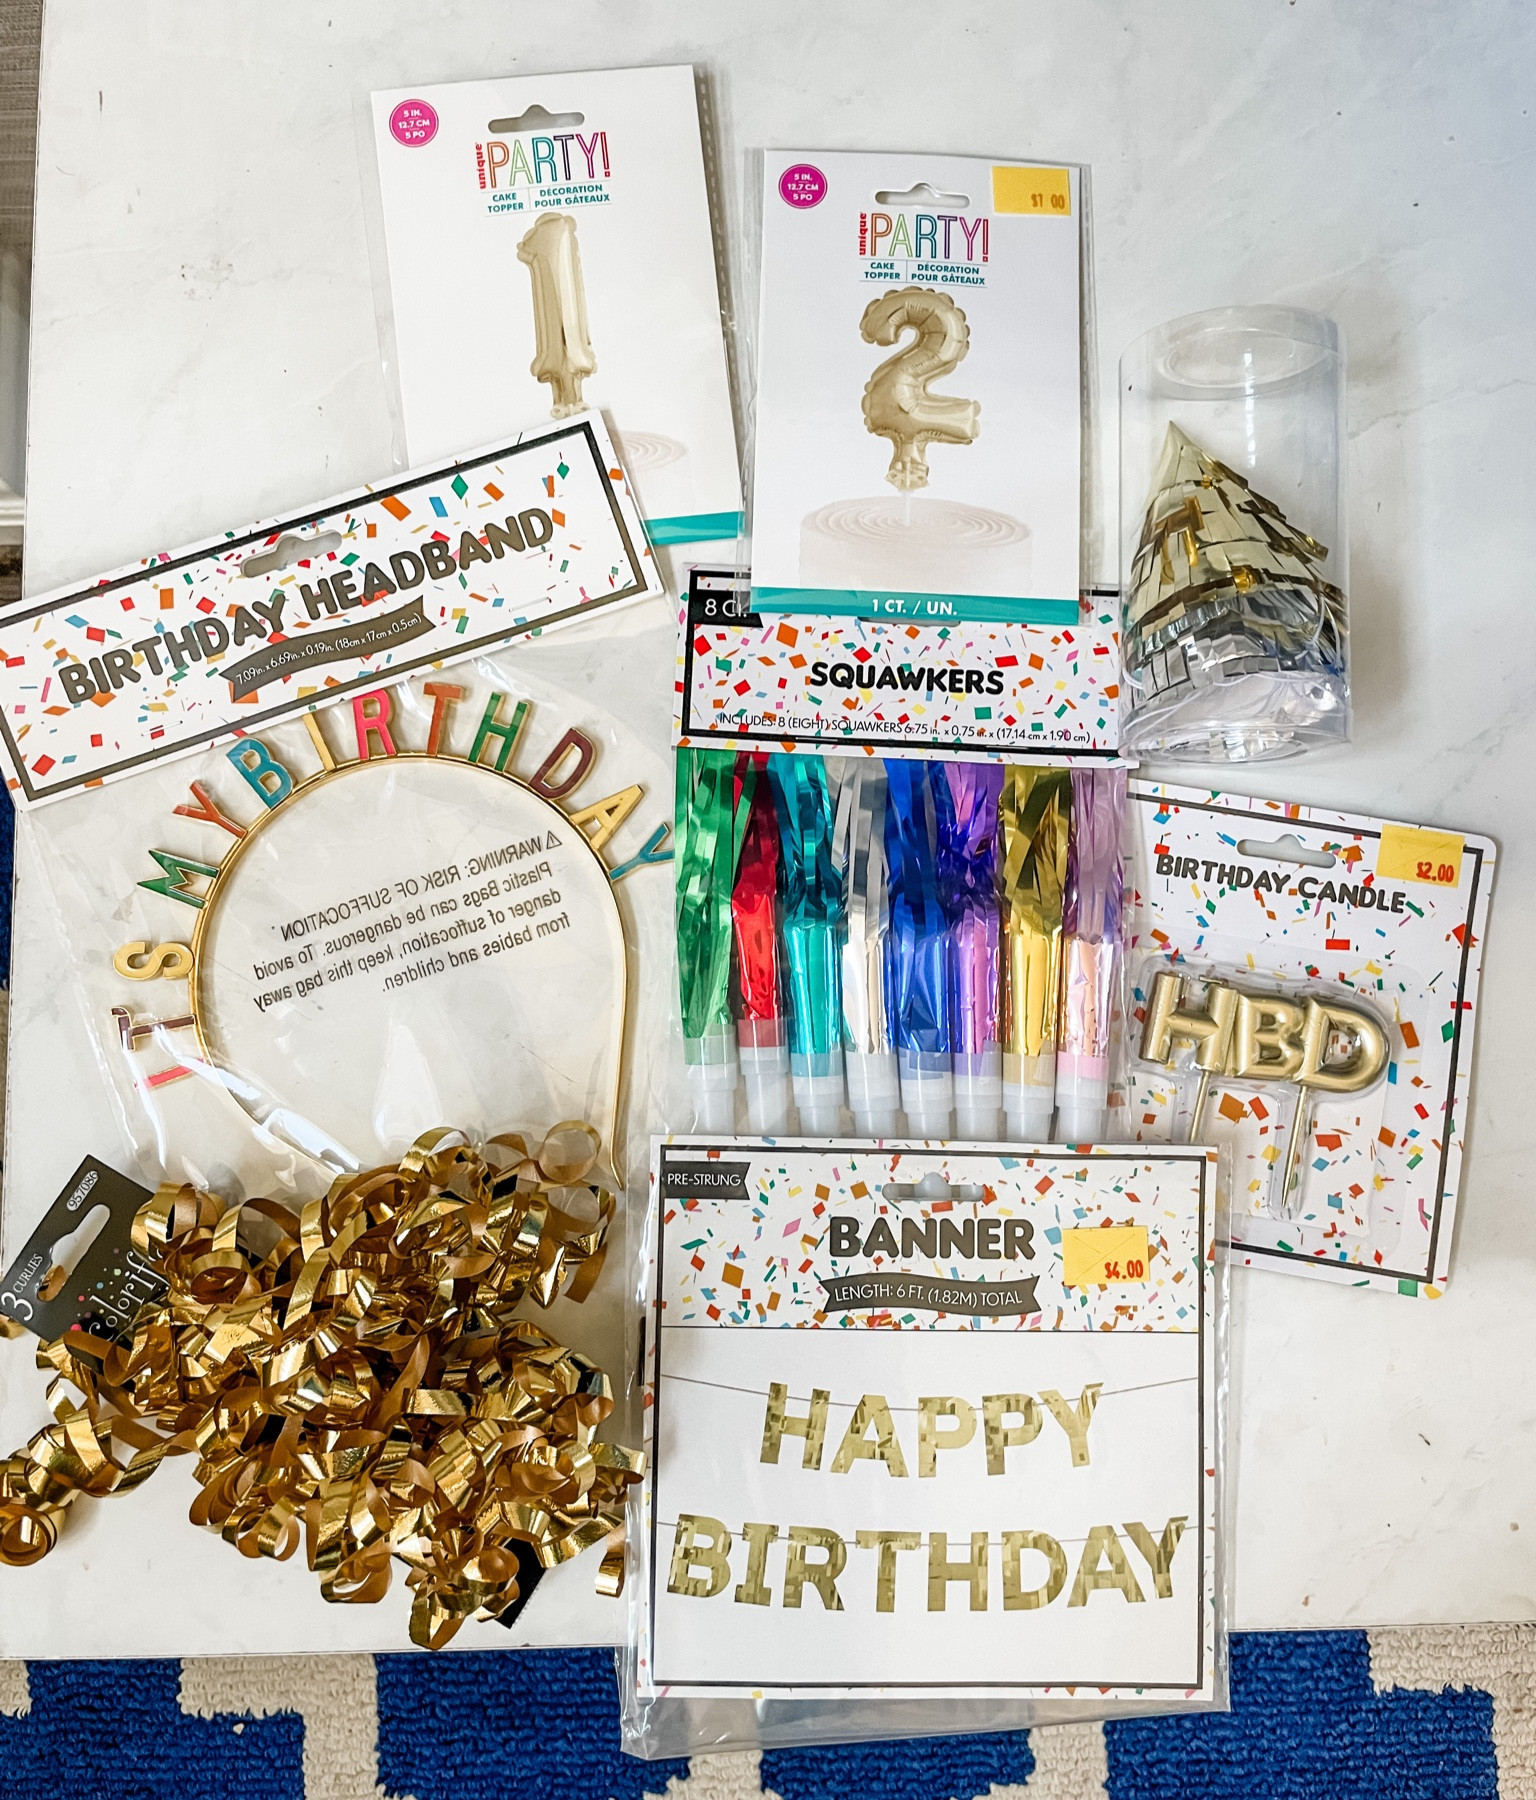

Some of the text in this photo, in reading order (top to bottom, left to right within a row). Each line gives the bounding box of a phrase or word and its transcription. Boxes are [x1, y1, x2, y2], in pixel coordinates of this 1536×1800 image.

[398, 119, 430, 129] 12.7 CM
[403, 109, 423, 118] 5 IN.
[405, 130, 425, 139] 5 PO
[475, 143, 487, 189] unique
[486, 131, 611, 188] PARTY!
[787, 183, 819, 191] 12.7 CM
[794, 173, 813, 181] 5 IN.
[487, 202, 524, 214] TOPPER
[492, 192, 517, 202] CAKE
[534, 193, 611, 208] POUR GÂTEAUX
[793, 193, 813, 201] 5 PO
[859, 213, 867, 255] unique
[870, 212, 989, 262] PARTY!
[864, 271, 901, 280] TOPPER
[870, 262, 895, 270] CAKE
[917, 262, 979, 275] DÉCORATION
[911, 272, 985, 286] POUR GÂTEAUX
[57, 507, 554, 704] BIRTHDAY HEADBAND
[705, 598, 717, 616] 8
[872, 599, 879, 613] 1
[885, 599, 908, 614] CT.
[927, 601, 958, 616] UN.
[809, 661, 1004, 695] SQUAWKERS
[719, 713, 776, 727] INCLUDES:
[778, 717, 786, 728] 8
[788, 716, 830, 731] (EIGHT)
[831, 719, 903, 733] SQUAWKERS
[904, 723, 928, 734] 6.75
[930, 726, 941, 735] in.
[951, 725, 975, 737] 0.75
[996, 728, 1026, 740] (17.14
[1050, 730, 1072, 741] 1.90
[1073, 732, 1091, 743] cm)
[137, 779, 248, 909] MY
[225, 681, 675, 882] BIRTHDAY
[1416, 861, 1455, 883] $2.00
[1155, 853, 1407, 914] BIRTHDAY CANDLE
[1139, 971, 1392, 1093] HBD
[68, 1170, 98, 1208] 957086
[667, 1172, 741, 1188] PRE-STRUNG
[828, 1215, 1036, 1261] BANNER
[1104, 1259, 1144, 1280] $4.00
[0, 1253, 44, 1321] 3 CURLIES
[88, 1247, 170, 1342] Colorif
[834, 1284, 1023, 1308] LENGTH: 6 FT. (1.82M) TOTAL
[759, 1381, 1104, 1478] HAPPY
[666, 1513, 1189, 1613] BIRTHDAY
